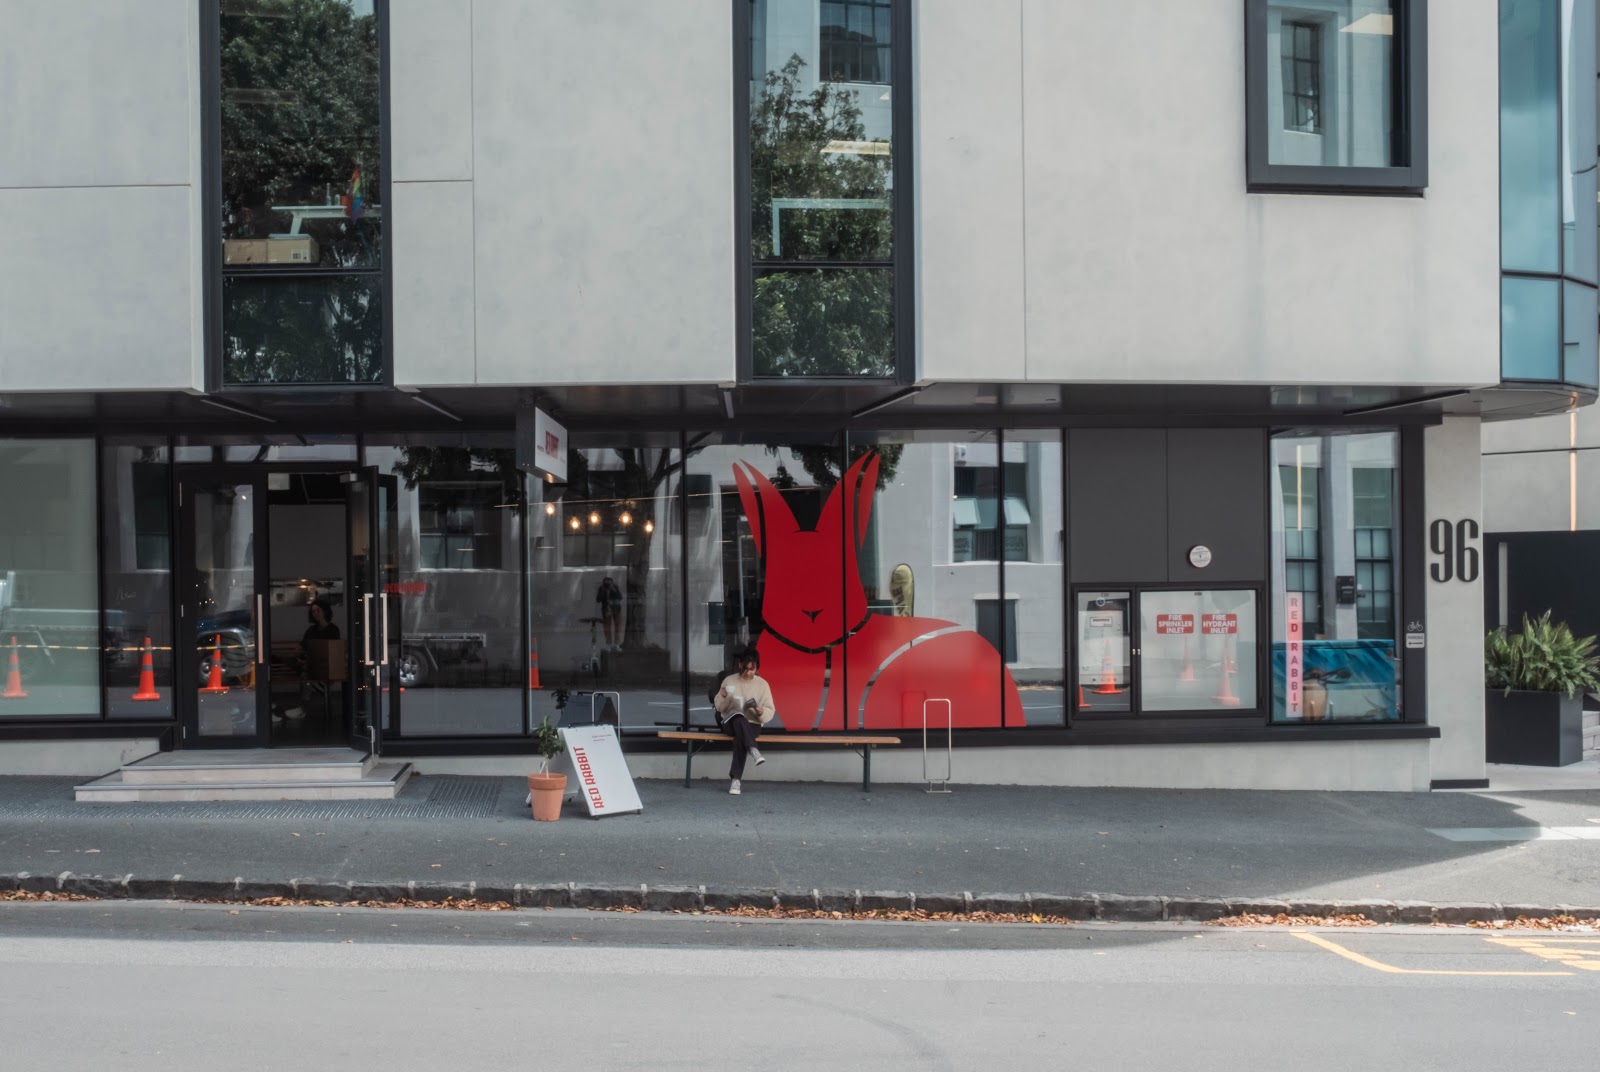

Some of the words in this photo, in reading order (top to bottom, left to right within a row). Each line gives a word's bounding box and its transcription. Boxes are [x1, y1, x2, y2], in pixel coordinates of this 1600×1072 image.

[1430, 518, 1479, 583] 96
[1203, 620, 1236, 628] HYDRANT
[1290, 597, 1298, 633] RED
[1290, 642, 1298, 712] RABBIT
[573, 746, 596, 785] RABBIT
[588, 787, 604, 808] RED
